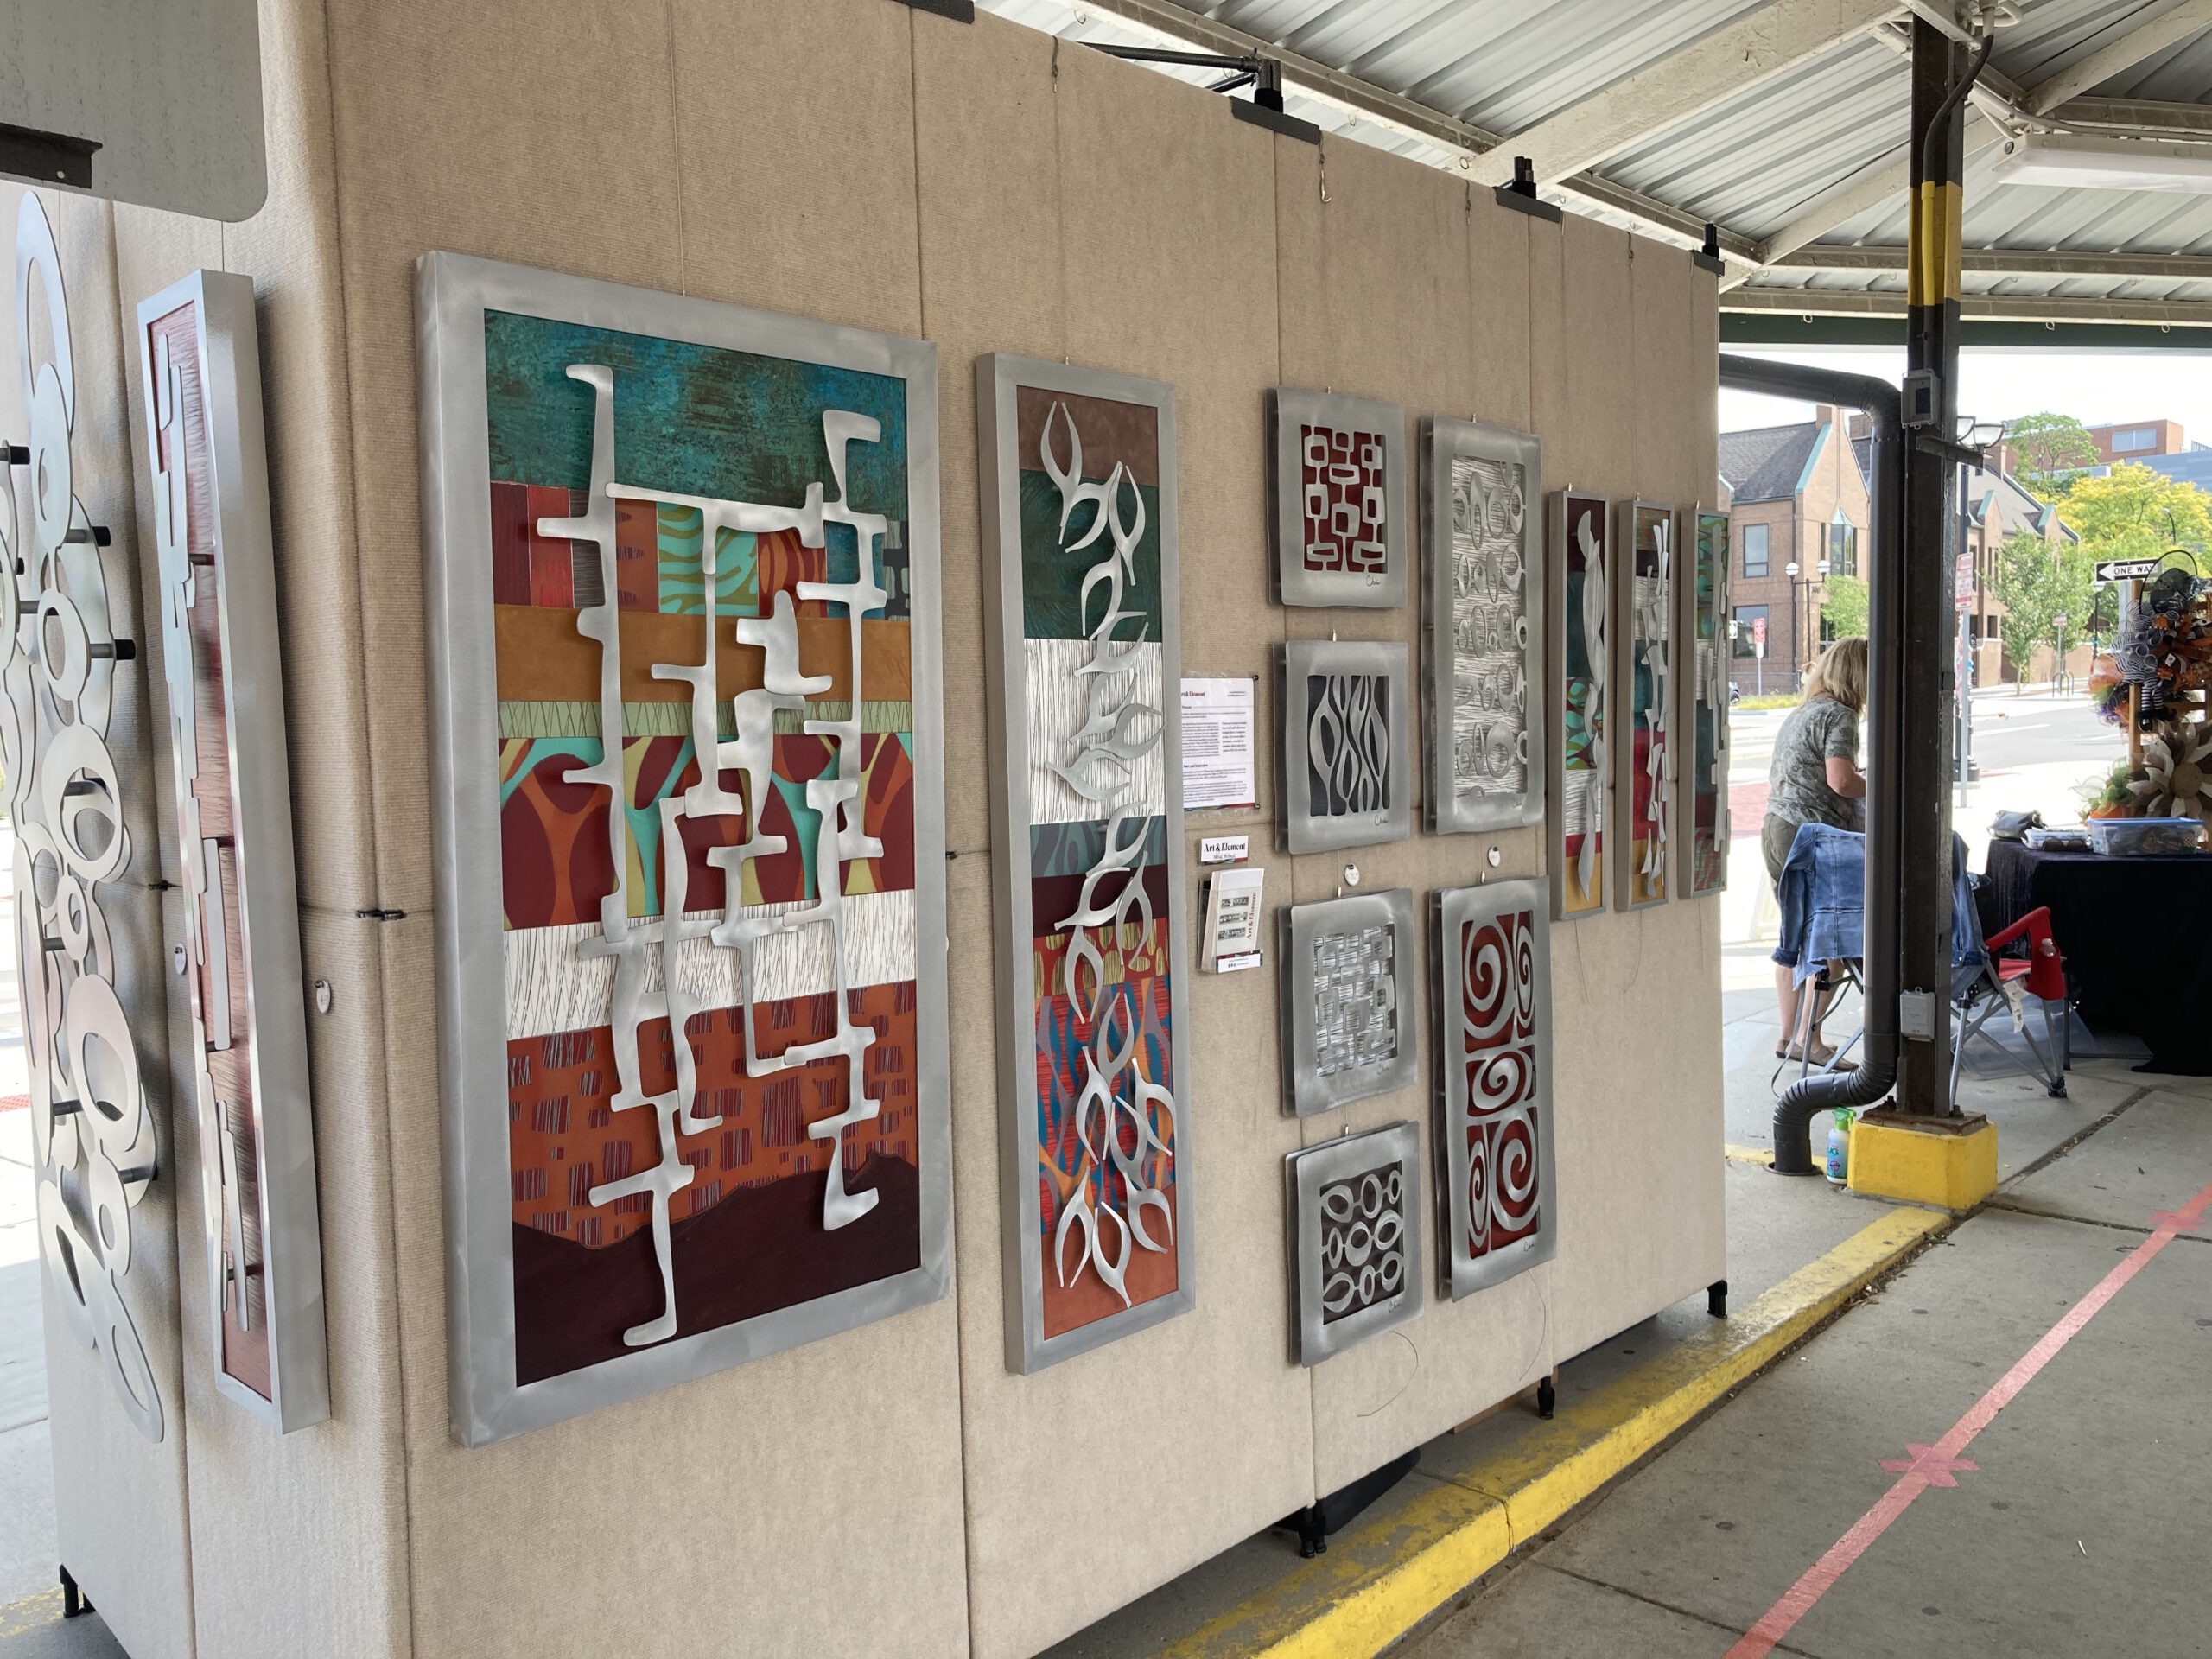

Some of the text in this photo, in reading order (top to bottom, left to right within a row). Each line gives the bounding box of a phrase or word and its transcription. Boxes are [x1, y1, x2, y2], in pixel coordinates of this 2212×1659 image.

[2113, 566, 2133, 575] ONE
[1204, 842, 1246, 852] Art & Element
